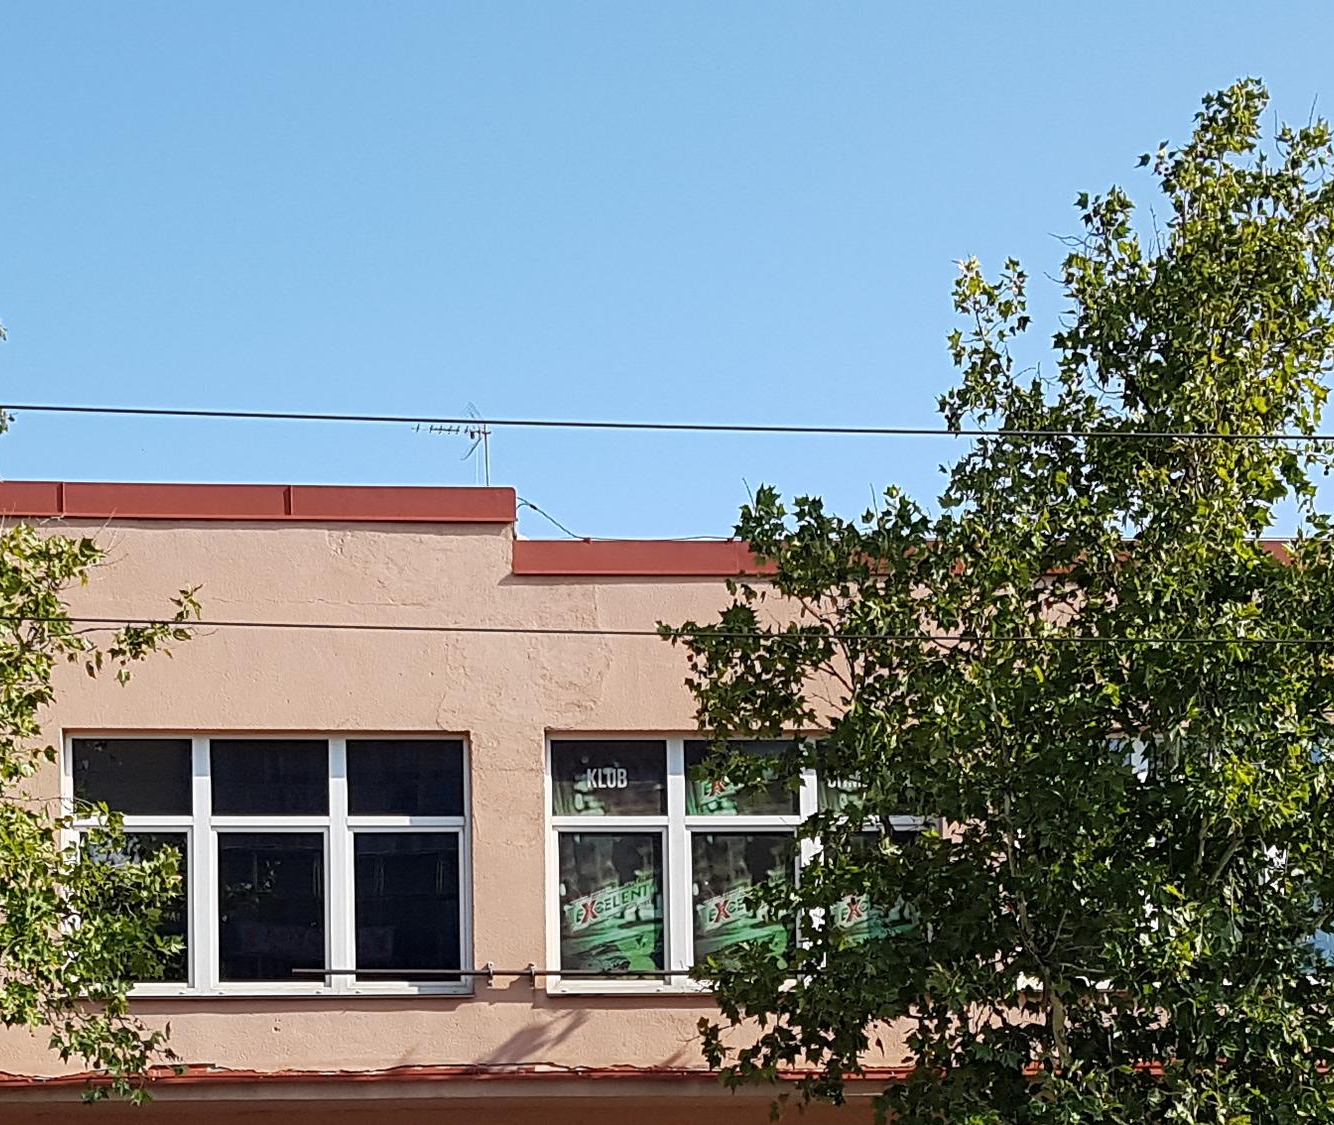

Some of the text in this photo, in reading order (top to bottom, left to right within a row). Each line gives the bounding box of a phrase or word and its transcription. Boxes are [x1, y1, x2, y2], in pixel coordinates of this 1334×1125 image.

[587, 768, 628, 788] KLUB
[575, 884, 649, 924] EXCELENT
[708, 897, 747, 924] EXCE
